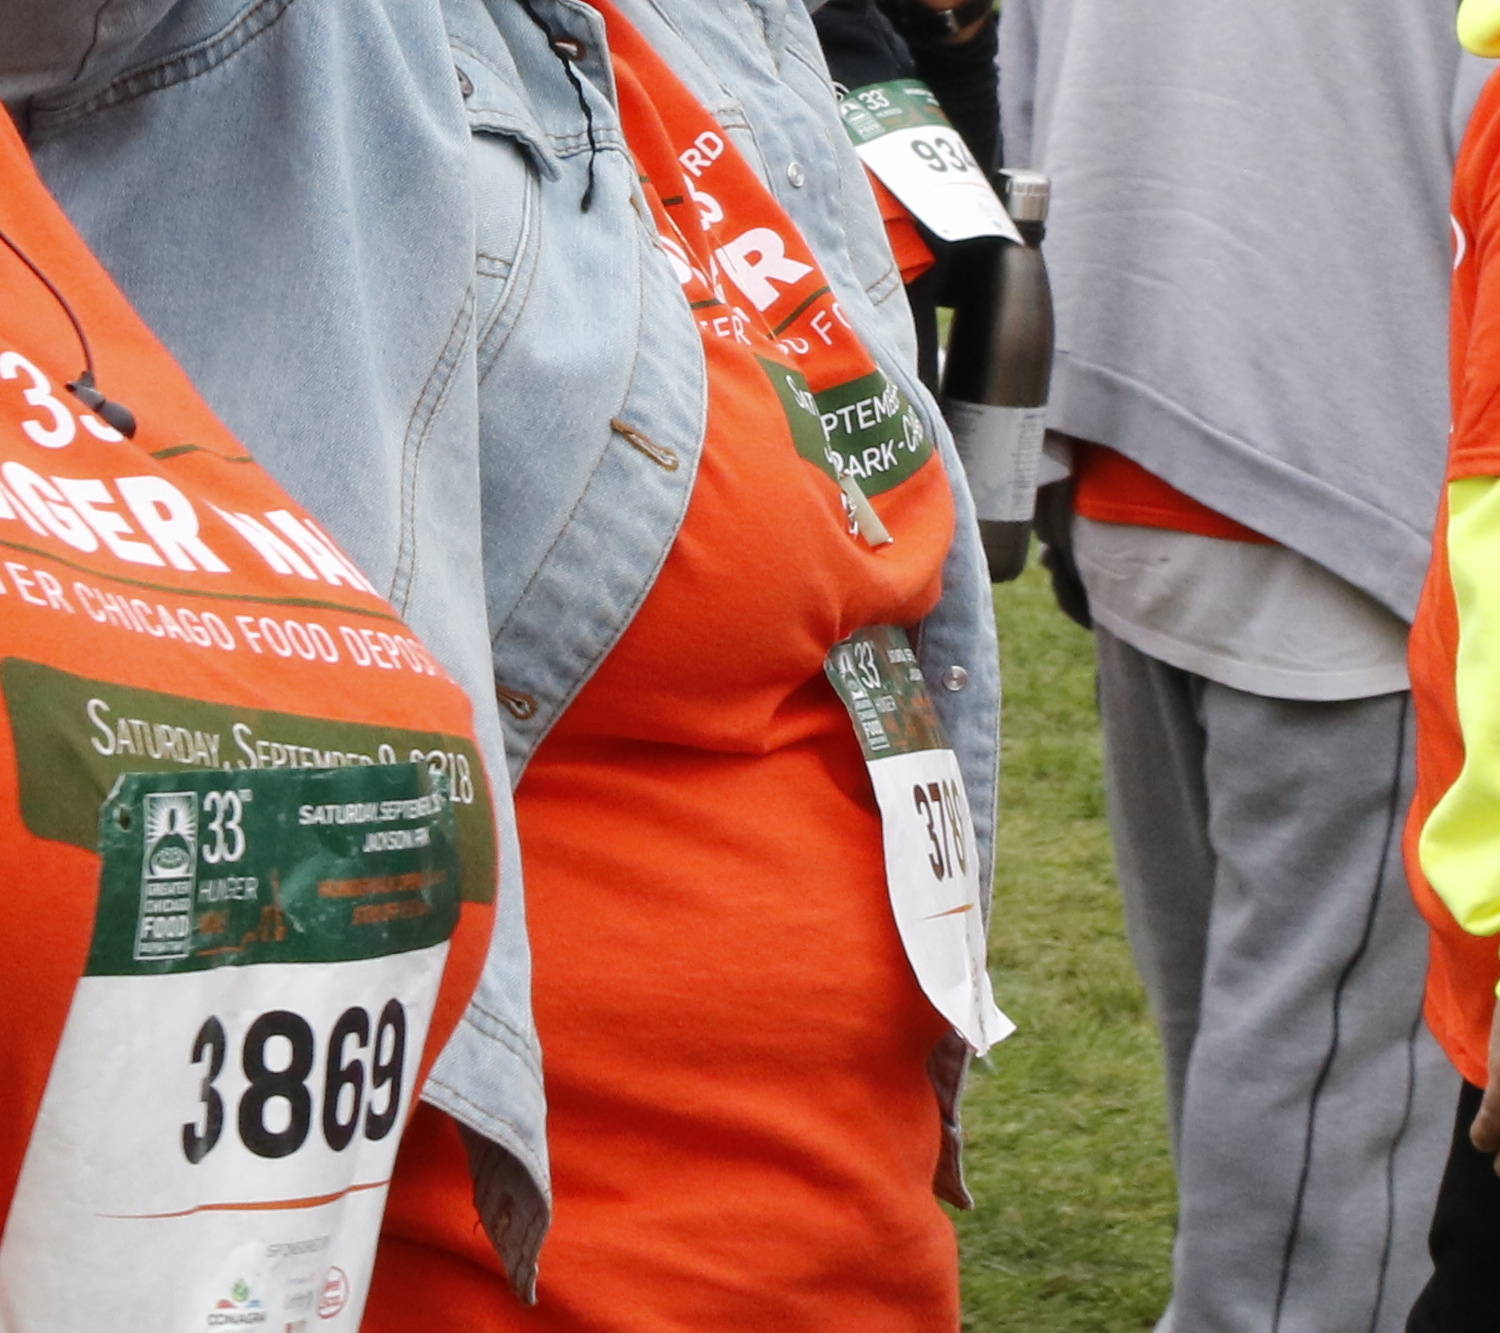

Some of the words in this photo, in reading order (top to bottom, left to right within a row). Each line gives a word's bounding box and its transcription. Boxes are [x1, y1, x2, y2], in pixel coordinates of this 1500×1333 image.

[73, 580, 237, 652] CHICAGO
[233, 614, 339, 664] FOOD
[181, 998, 410, 1165] 3869
